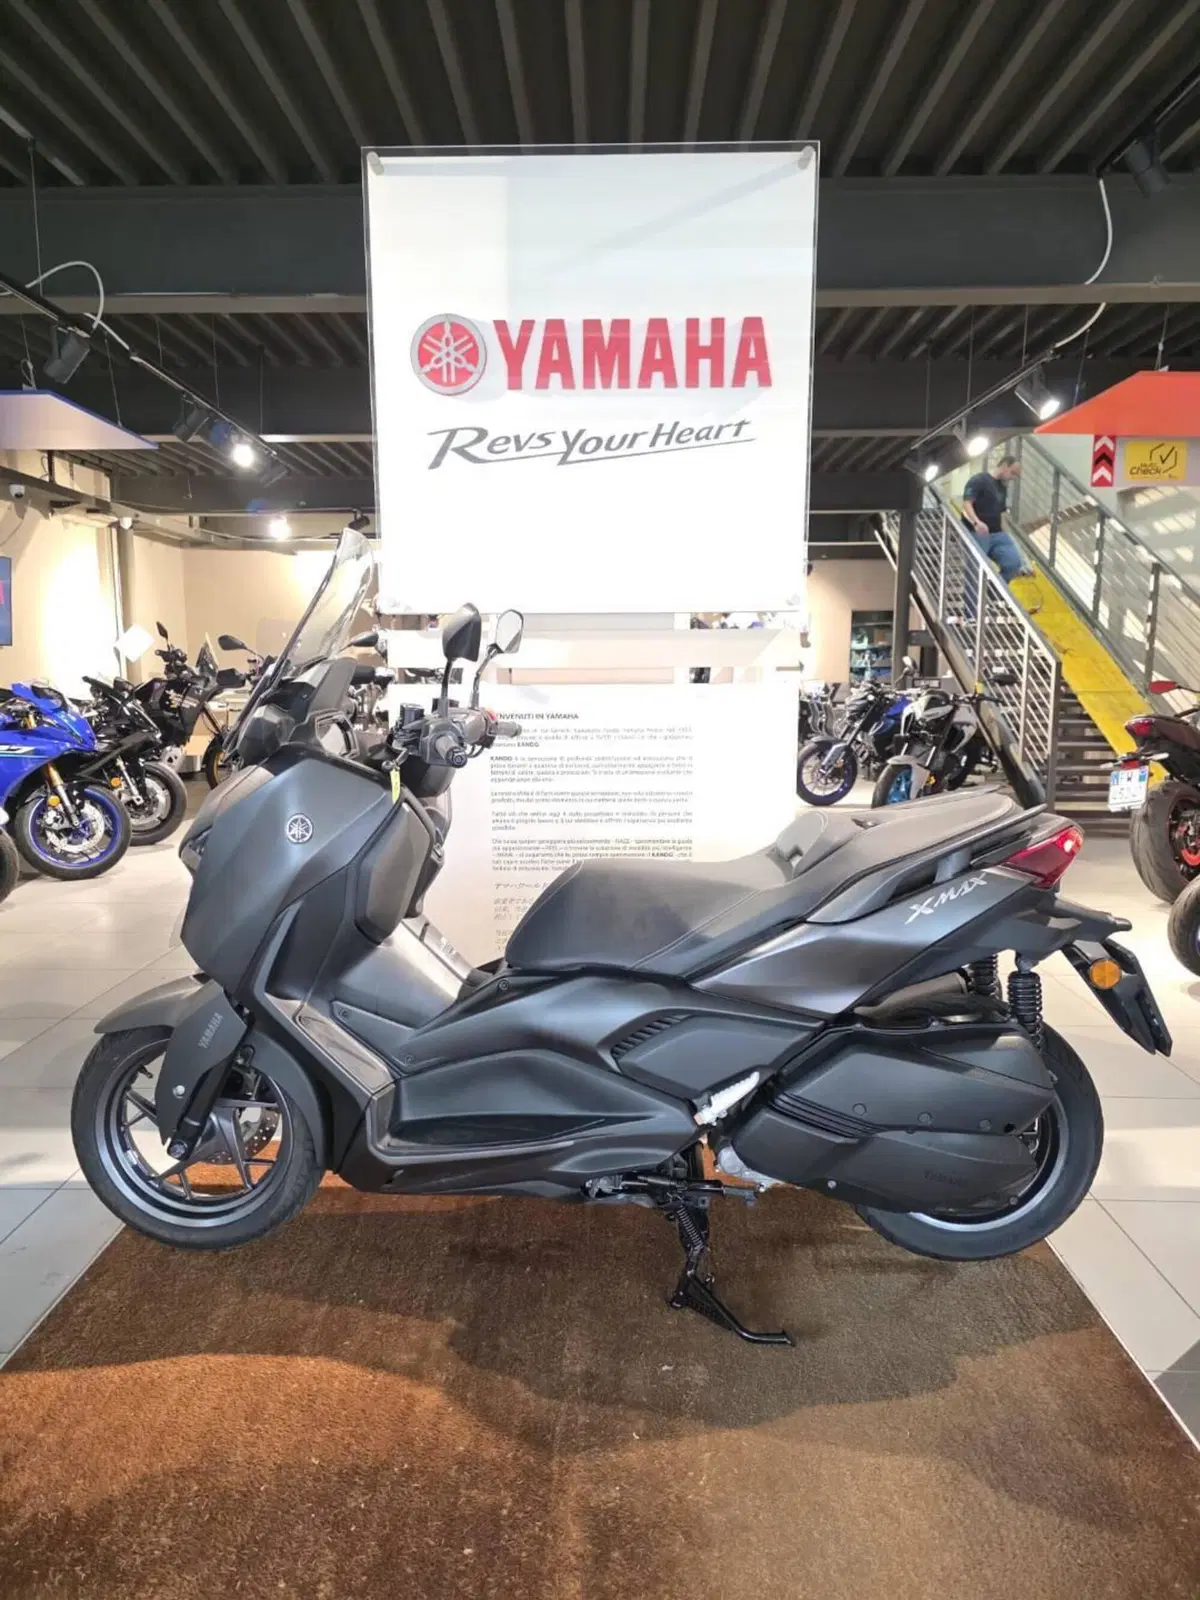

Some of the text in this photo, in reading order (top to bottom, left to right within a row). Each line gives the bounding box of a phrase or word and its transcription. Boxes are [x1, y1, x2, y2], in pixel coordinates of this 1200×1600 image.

[493, 317, 772, 390] YAMAHA
[428, 419, 752, 469] Revs Your Heart
[197, 1012, 223, 1049] YAMAHA
